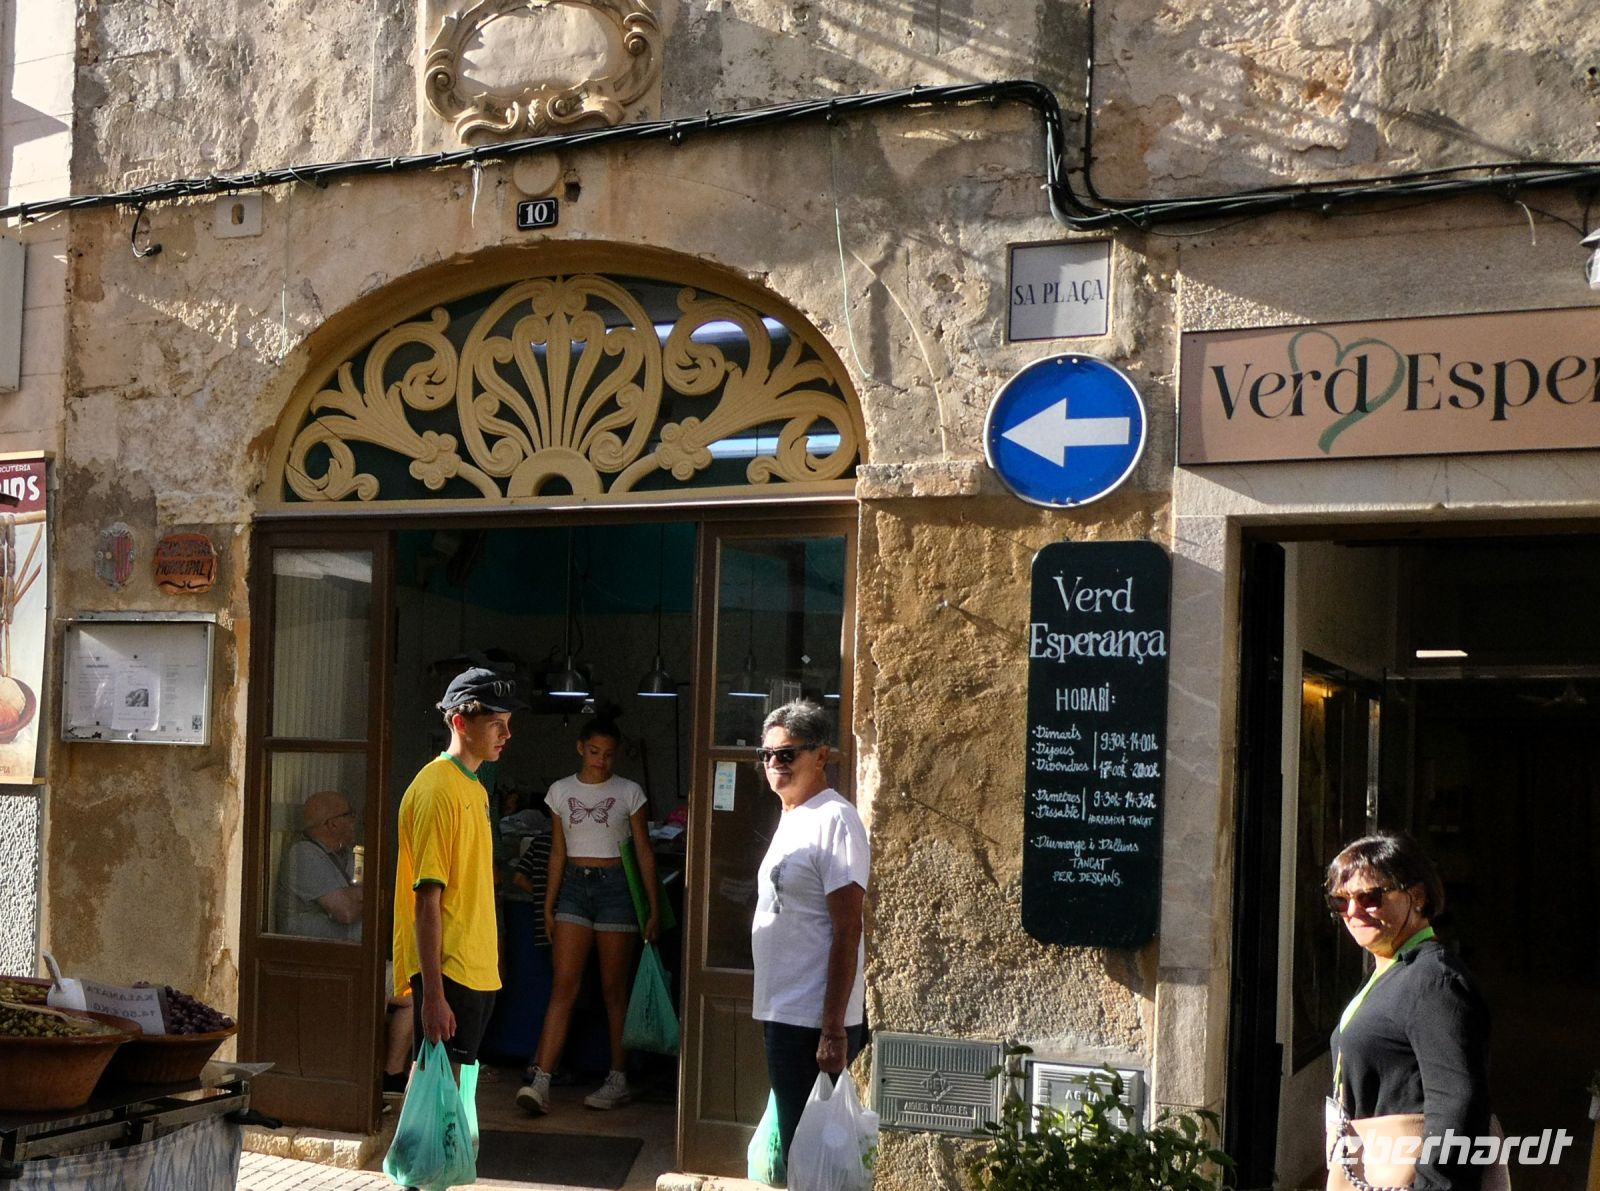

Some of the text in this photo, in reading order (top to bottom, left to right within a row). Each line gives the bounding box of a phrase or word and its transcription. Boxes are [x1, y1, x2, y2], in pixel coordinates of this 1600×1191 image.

[526, 203, 548, 224] 10
[1014, 280, 1104, 306] SA PLAÇA
[1210, 354, 1369, 420] Verd
[1053, 576, 1135, 613] Verd
[1029, 622, 1167, 665] Esperança
[1036, 723, 1082, 740] Dimarts
[1036, 741, 1075, 761] Dijous
[1121, 752, 1129, 764] i
[1035, 803, 1080, 819] Dissabte
[1035, 835, 1086, 857] Diumenge
[1089, 838, 1096, 850] i
[1052, 871, 1076, 882] PER
[931, 1103, 968, 1115] POTABLES
